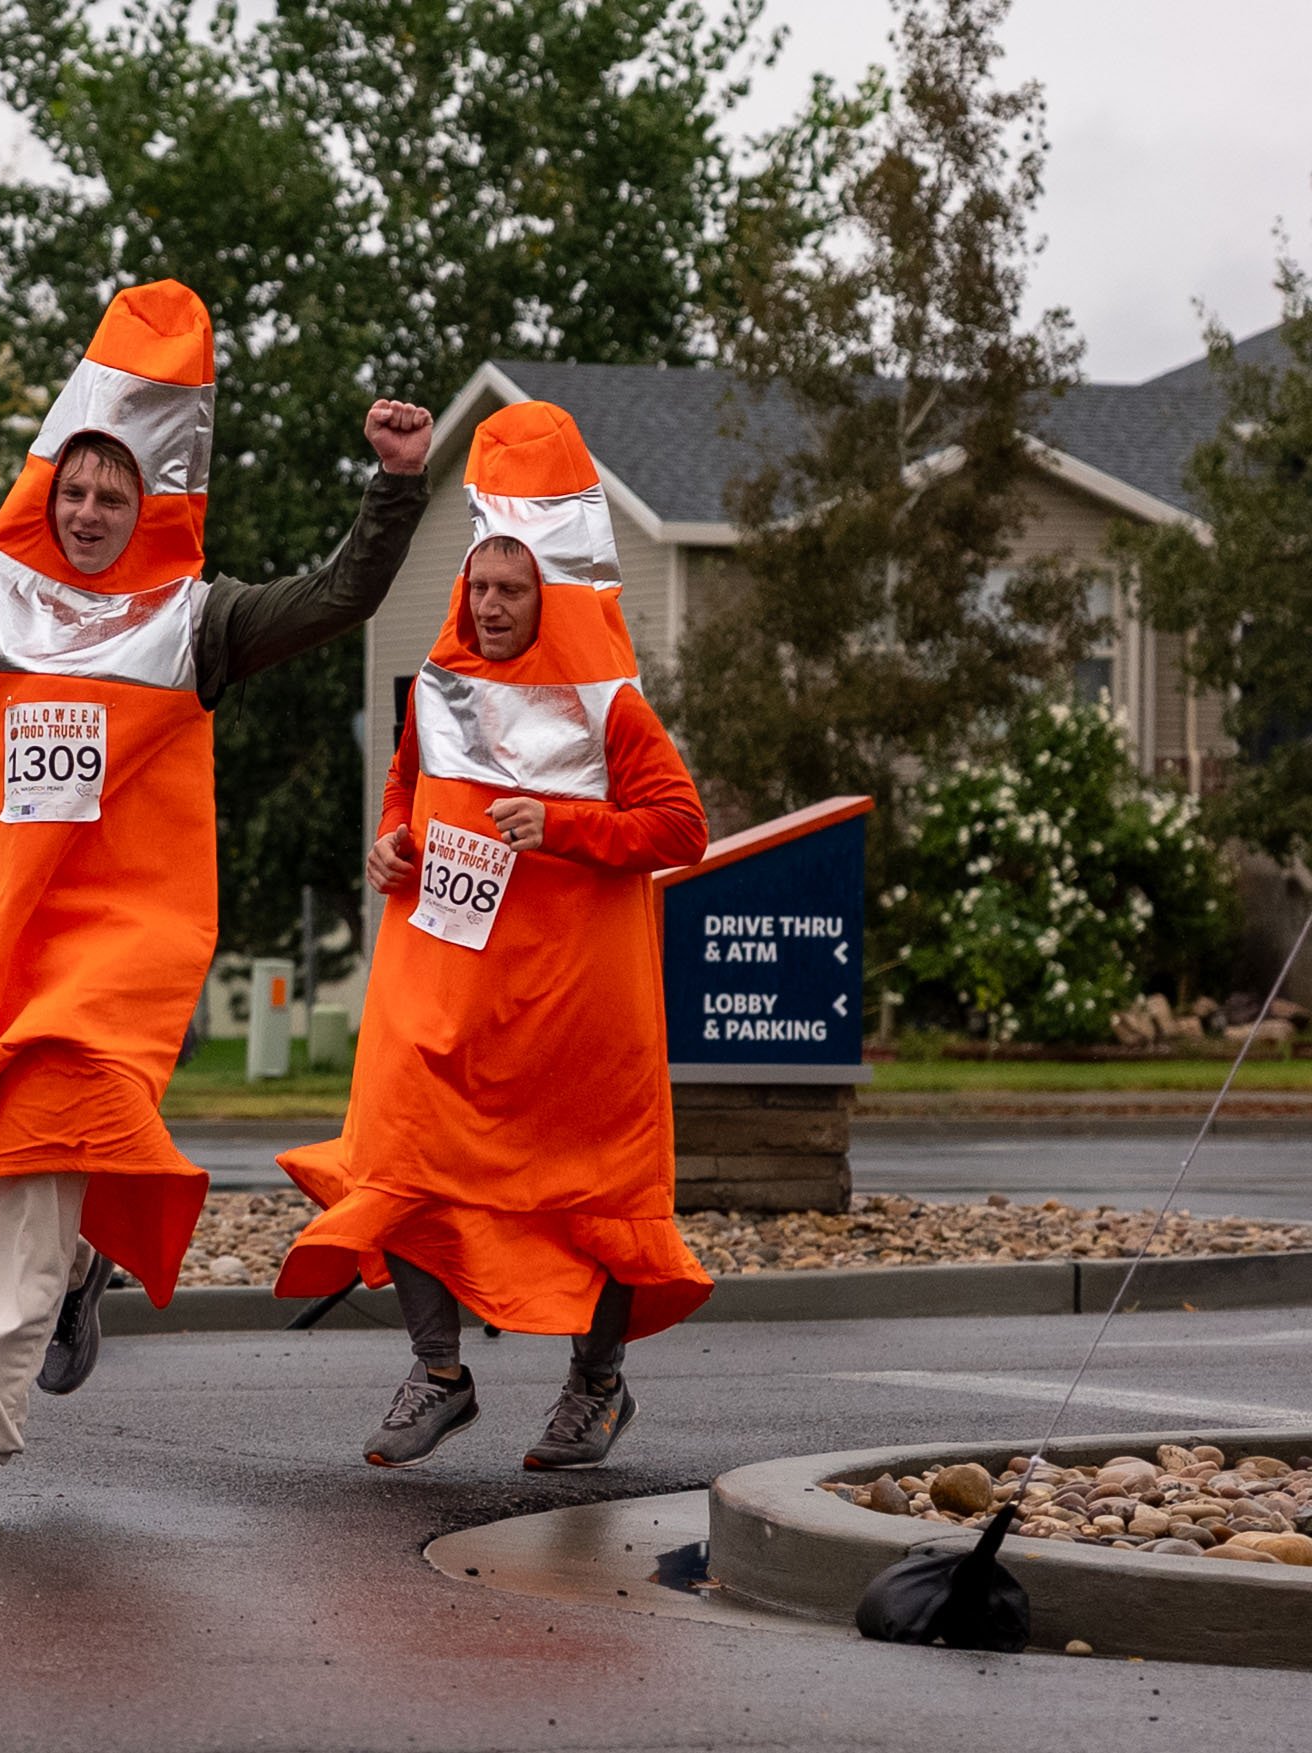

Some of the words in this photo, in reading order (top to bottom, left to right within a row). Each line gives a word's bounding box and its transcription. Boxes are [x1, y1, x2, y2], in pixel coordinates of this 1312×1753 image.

[20, 725, 44, 739] FOOD
[47, 724, 83, 739] TRUCK
[86, 725, 100, 739] 5K
[8, 745, 102, 783] 1309
[437, 843, 456, 861] FOOD
[457, 850, 489, 872] TRUCK
[491, 862, 506, 877] 5K
[423, 860, 500, 913] 1308
[704, 915, 774, 937] DRIVE
[779, 916, 843, 938] THRU
[704, 941, 721, 963] &
[726, 942, 778, 963] ATM
[703, 993, 778, 1015] LOBBY
[703, 1019, 720, 1040] &
[725, 1020, 827, 1041] PARKING
